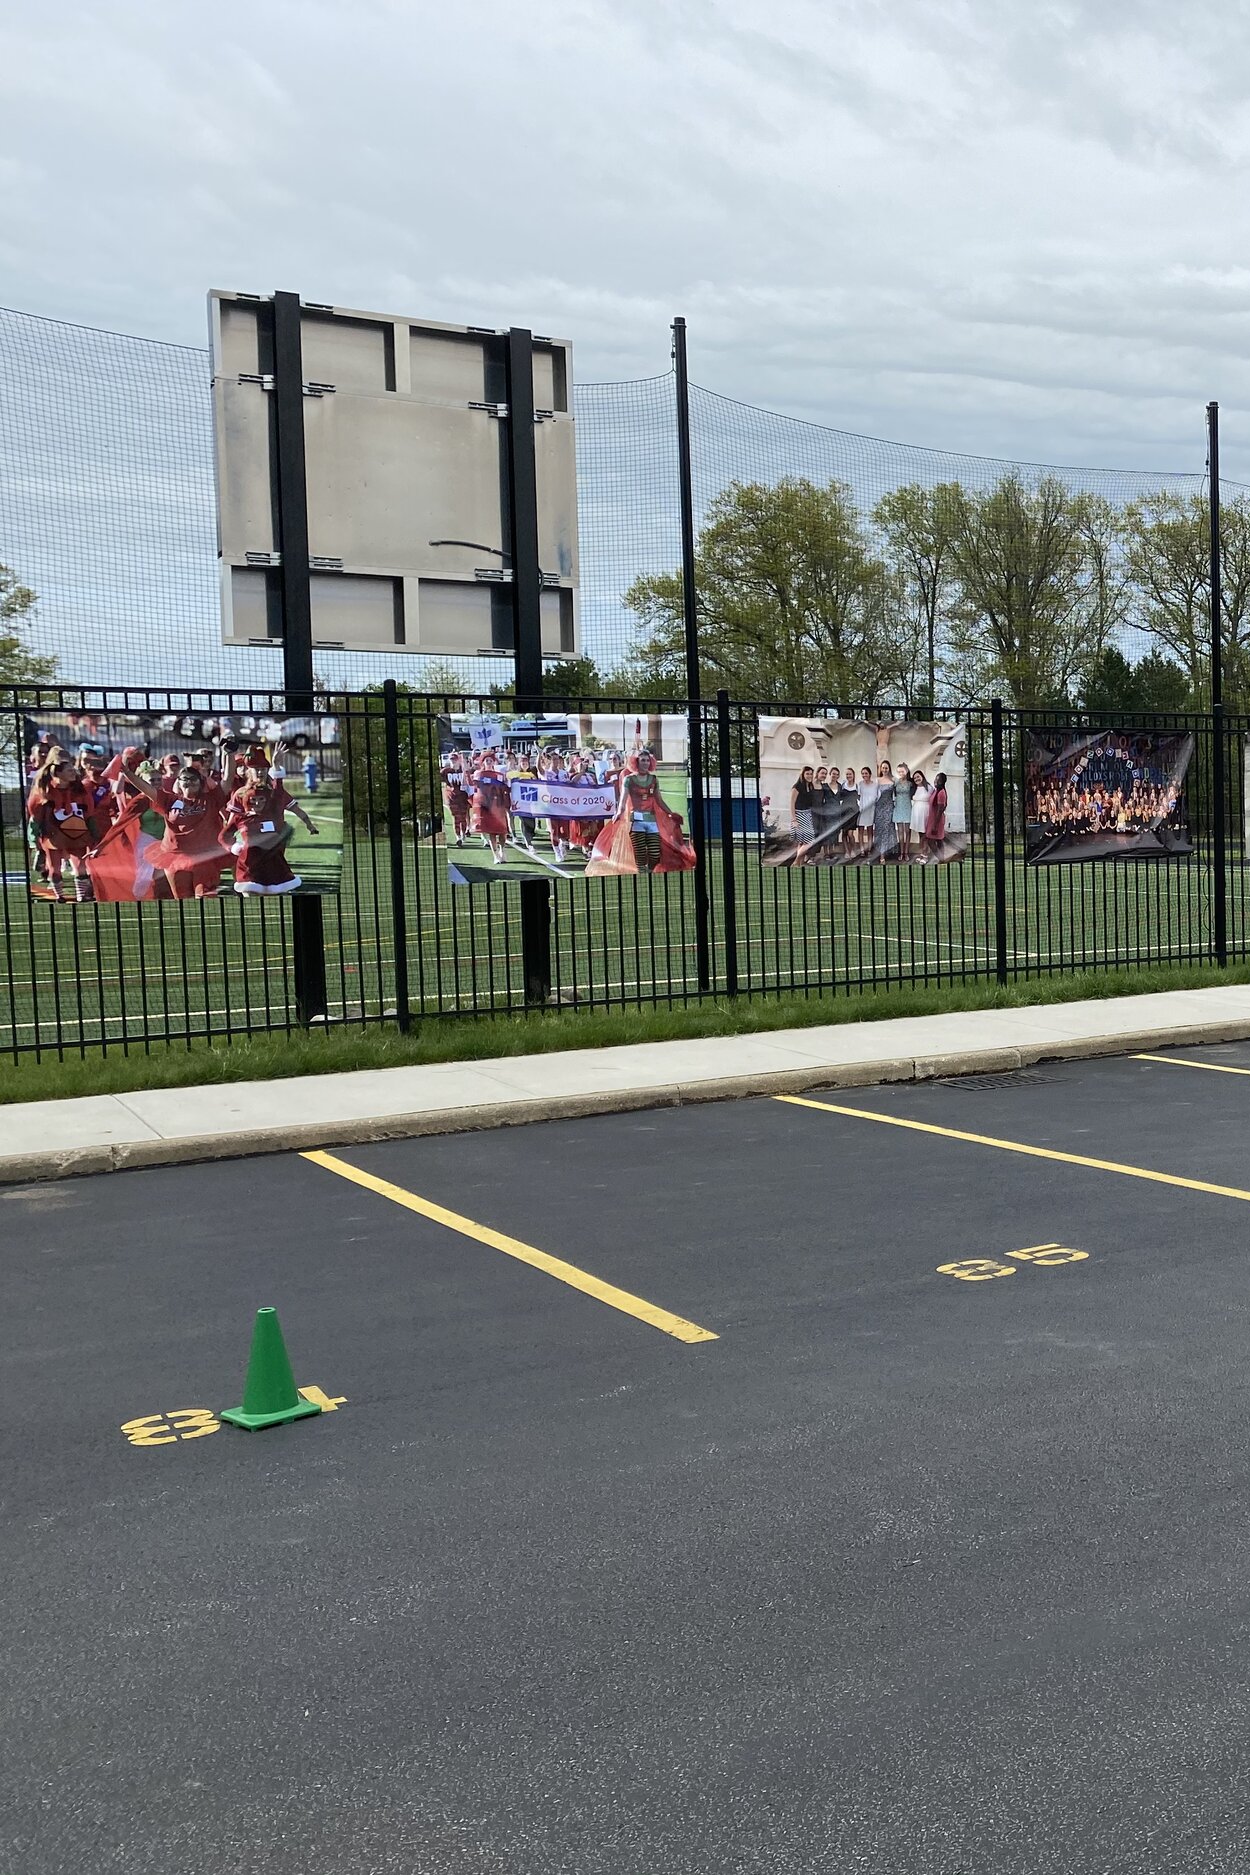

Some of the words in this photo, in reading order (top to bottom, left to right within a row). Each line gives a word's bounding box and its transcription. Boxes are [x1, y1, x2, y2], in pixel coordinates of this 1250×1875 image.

[541, 794, 569, 805] Class
[570, 796, 580, 806] of
[583, 795, 606, 806] 2020
[935, 1242, 1091, 1281] 85
